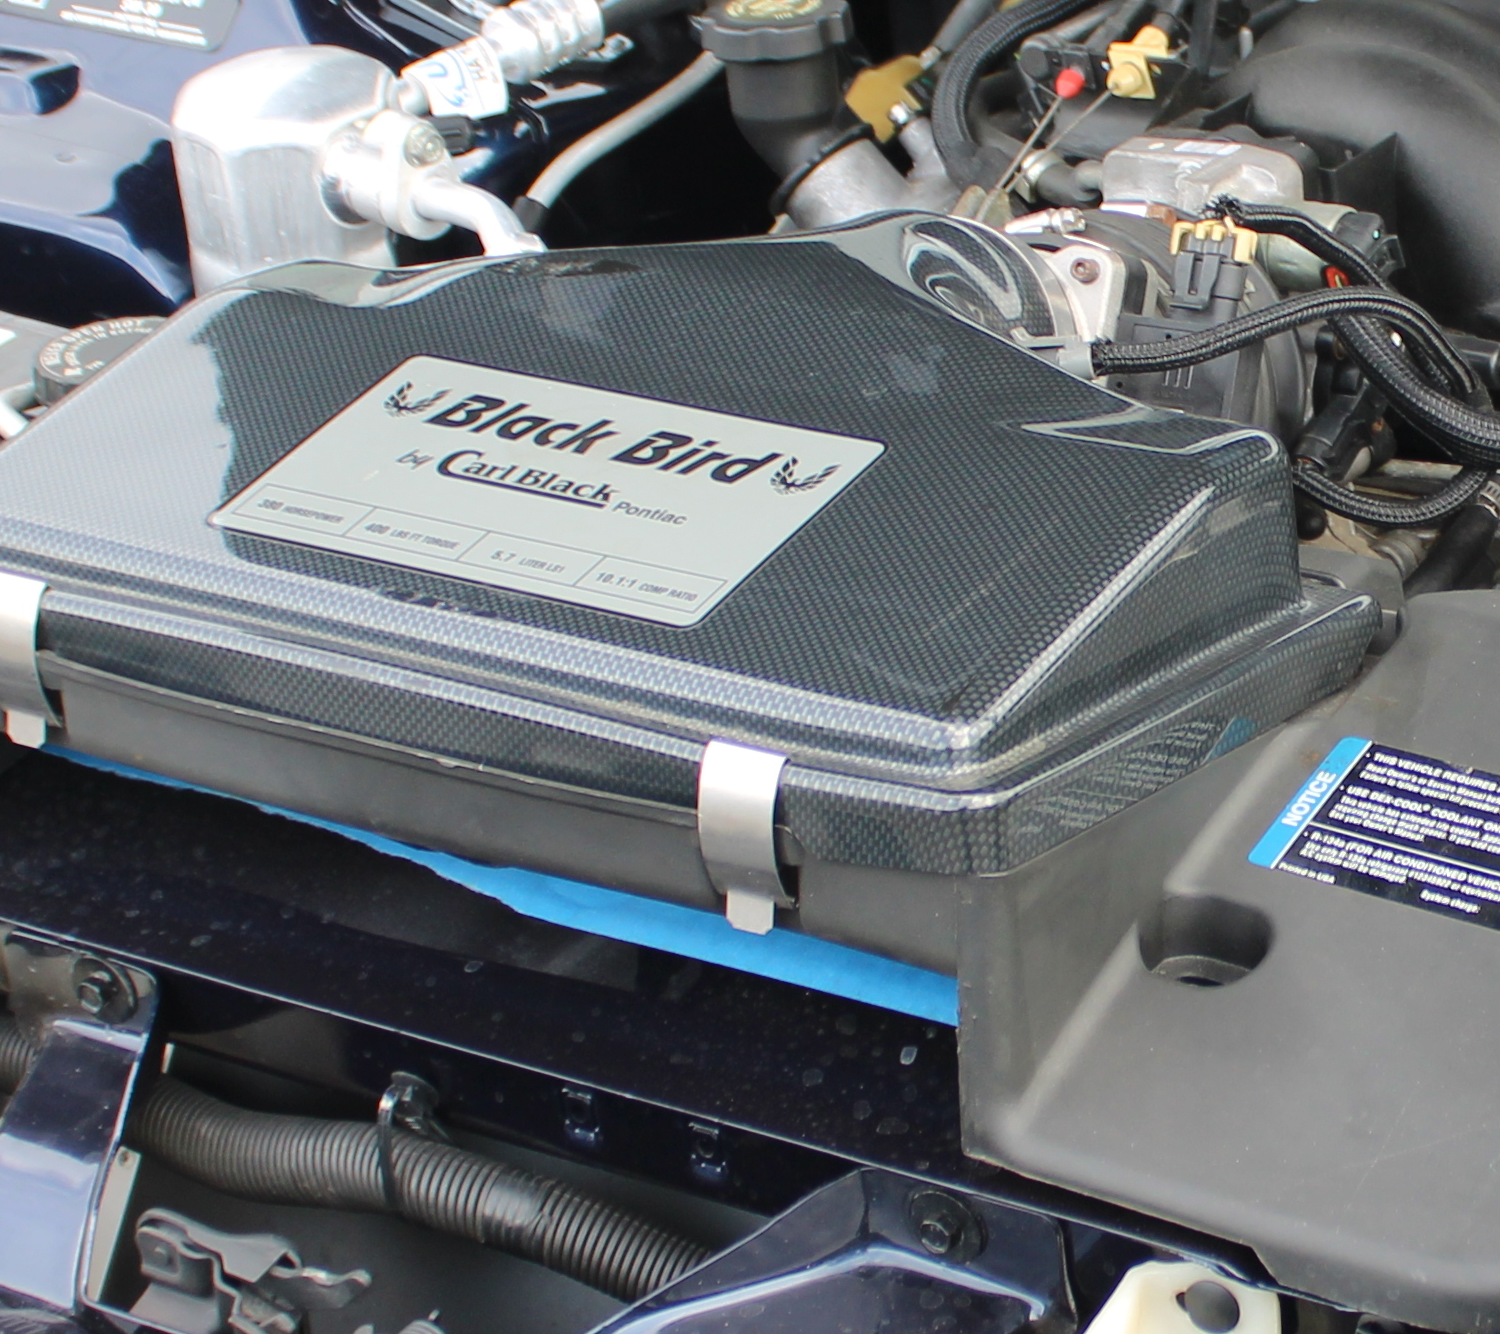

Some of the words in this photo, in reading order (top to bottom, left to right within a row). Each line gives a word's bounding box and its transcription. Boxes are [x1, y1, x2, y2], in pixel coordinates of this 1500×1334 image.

[425, 395, 616, 454] Black
[611, 431, 782, 483] Bird
[396, 450, 433, 469] by
[437, 450, 517, 480] Carl
[514, 469, 616, 502] Black
[613, 502, 686, 524] Pontiac
[282, 506, 344, 523] HORSEPOWER
[422, 536, 459, 549] TORQUE
[491, 551, 516, 562] 5.7
[519, 558, 547, 568] LITER
[597, 573, 637, 587] 10.1:1
[639, 583, 669, 594] COMP
[668, 589, 697, 601] RATIO
[1366, 763, 1387, 774] Read
[1386, 768, 1417, 783] Owner's
[1374, 753, 1398, 765] THIS
[1398, 759, 1442, 777] VEHICLE
[1442, 771, 1497, 791] REQUIRES
[1281, 770, 1337, 827] NOTICE
[1347, 786, 1370, 798] USE
[1431, 805, 1484, 827] COOLANT
[1278, 861, 1308, 876] Printed
[1307, 870, 1317, 878] in
[1316, 872, 1335, 884] USA
[1311, 831, 1346, 848] R-134a
[1345, 842, 1373, 855] (FOR
[1373, 849, 1394, 861] AIR
[1393, 854, 1467, 881] CONDITIONED
[1421, 890, 1451, 904] System
